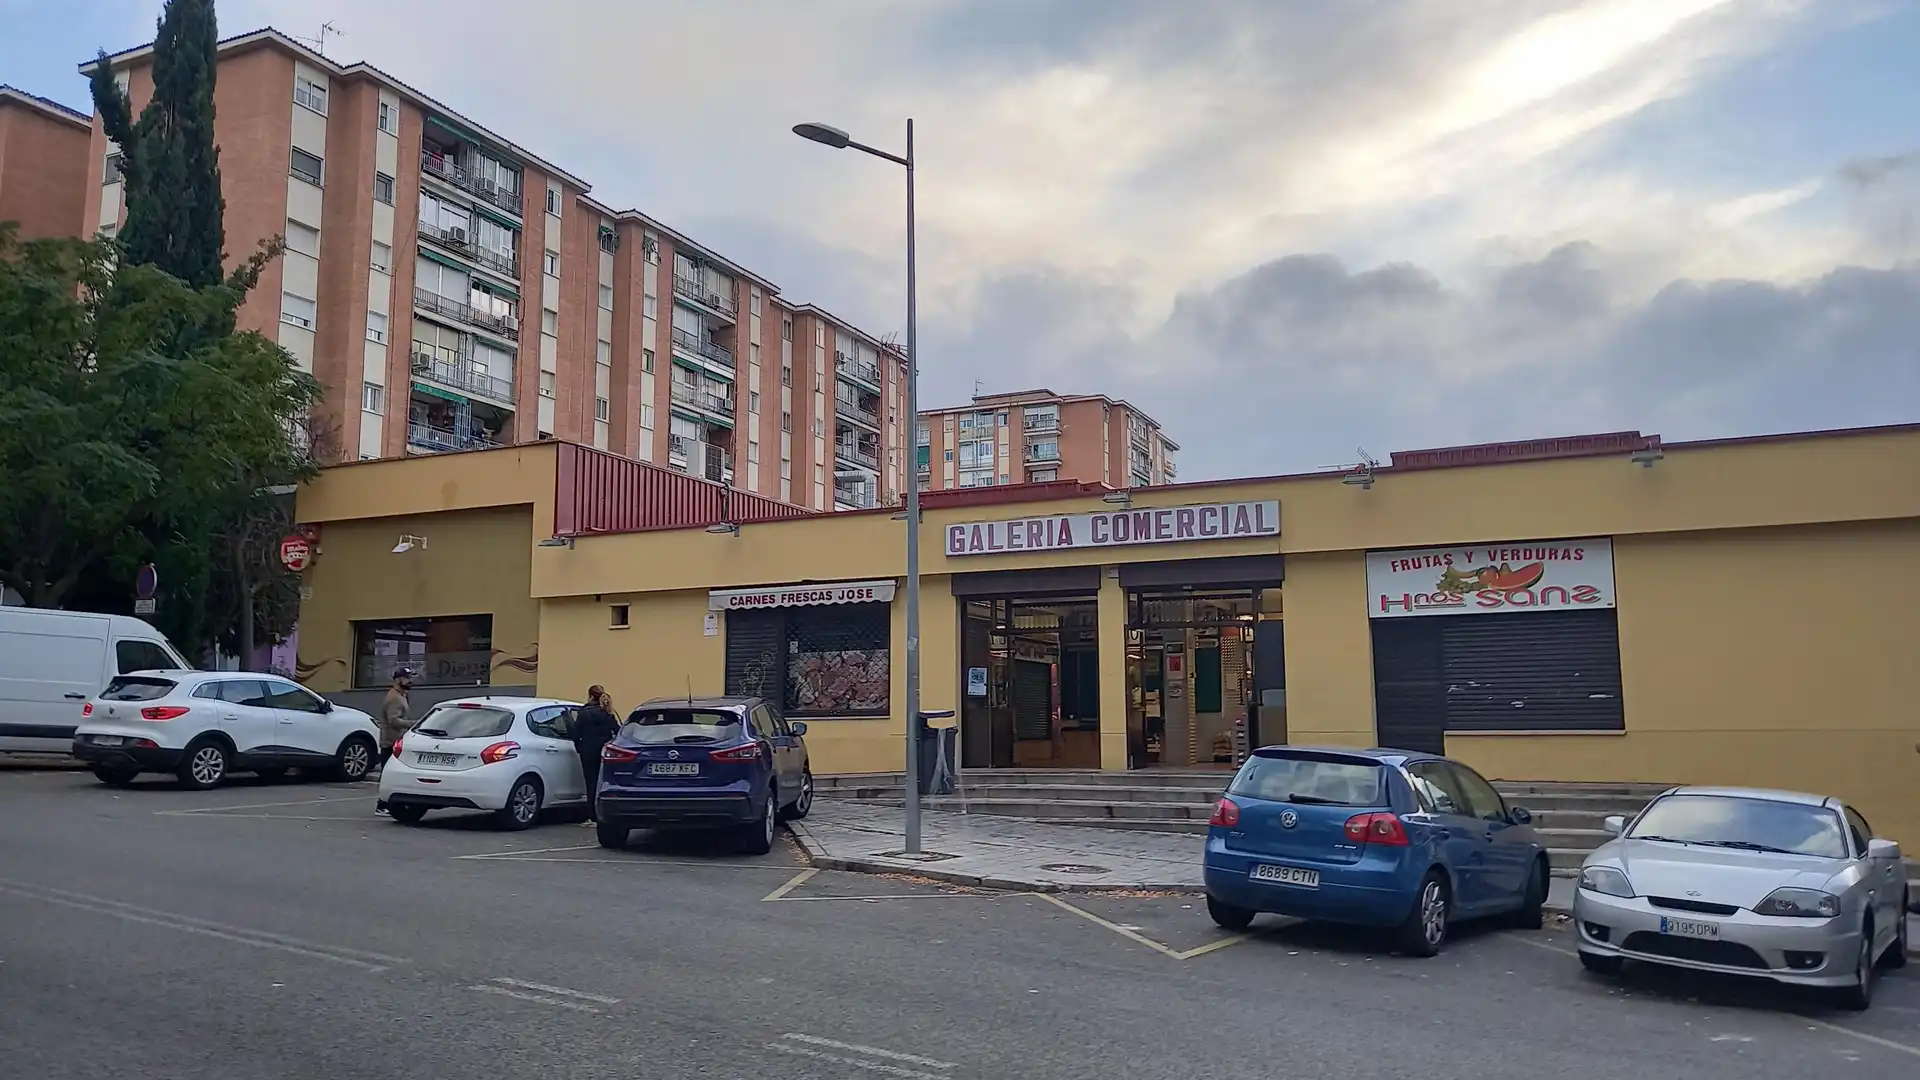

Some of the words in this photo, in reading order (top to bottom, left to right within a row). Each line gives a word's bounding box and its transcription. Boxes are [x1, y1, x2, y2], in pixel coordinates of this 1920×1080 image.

[949, 517, 1074, 553] GALERIA
[1091, 503, 1276, 544] COMERCIAL
[1391, 553, 1453, 573] FRUTAS
[1464, 551, 1474, 563] Y
[1487, 548, 1585, 562] VERDURAS
[729, 594, 776, 607] CARNES
[780, 590, 833, 604] FRESCAS
[838, 588, 874, 600] JOSE
[1258, 864, 1288, 881] 8689
[1292, 869, 1317, 884] CTN
[1667, 920, 1695, 934] 9195
[1697, 923, 1718, 937] DPM
